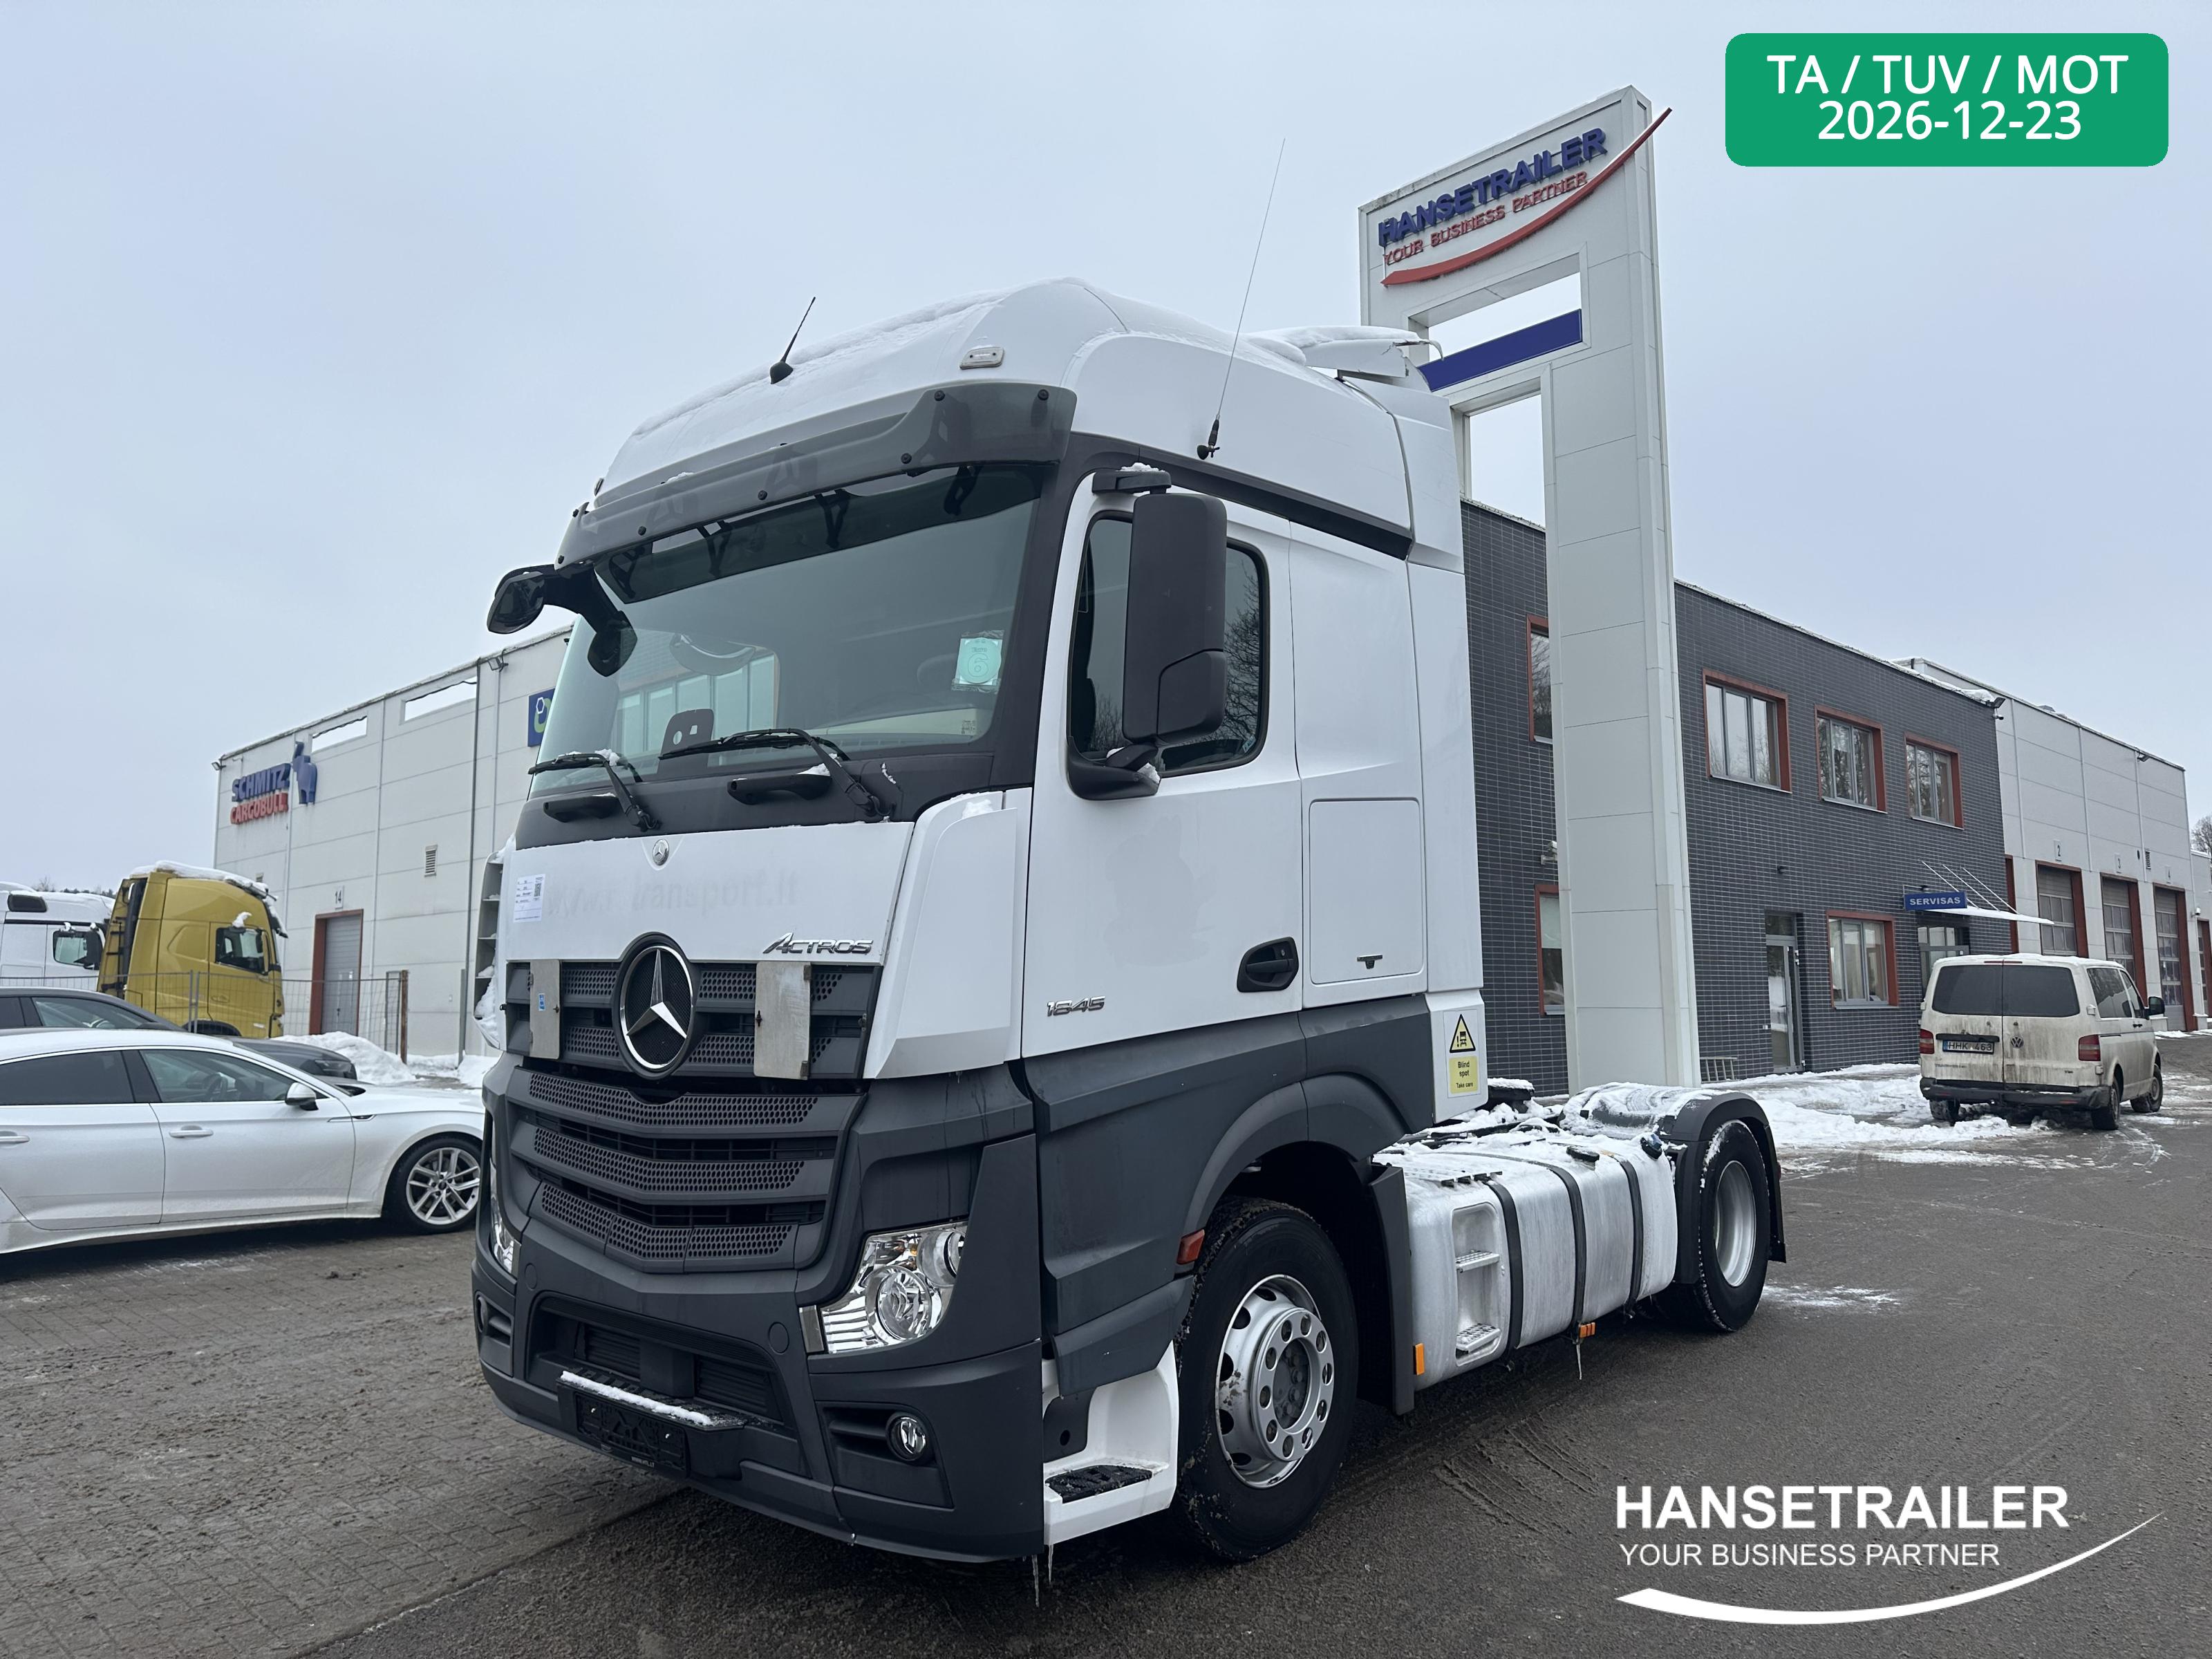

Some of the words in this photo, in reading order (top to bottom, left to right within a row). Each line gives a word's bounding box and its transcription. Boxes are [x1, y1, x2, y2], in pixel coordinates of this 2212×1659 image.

[1378, 128, 1608, 246] HANSETRAILER
[1384, 239, 1423, 265] YOUR
[1431, 205, 1505, 247] BUSINESS
[1512, 171, 1588, 212] PARTNER
[232, 763, 291, 802] SCHMITZ
[230, 792, 288, 825] CARGOBULL
[335, 890, 342, 904] 14
[1910, 897, 1960, 906] SERVISAS
[762, 932, 873, 955] ACTROS
[1047, 995, 1106, 1017] 1845
[1949, 1042, 1968, 1050] HHK
[1975, 1043, 1992, 1051] 463
[1459, 1069, 1470, 1078] spot
